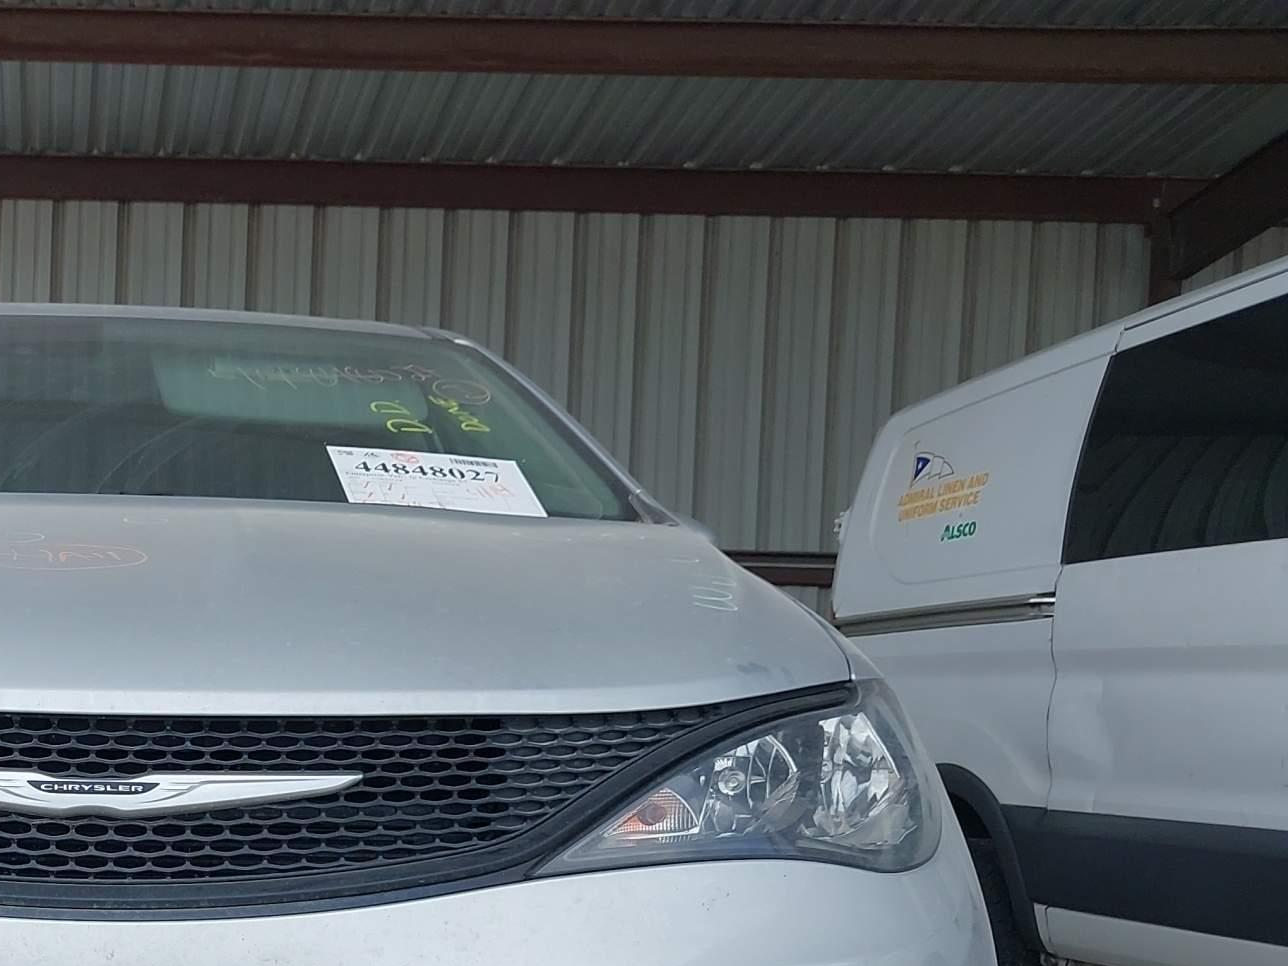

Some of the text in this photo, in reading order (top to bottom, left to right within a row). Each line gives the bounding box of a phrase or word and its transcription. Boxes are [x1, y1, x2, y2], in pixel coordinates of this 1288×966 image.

[355, 461, 499, 483] 44848027
[937, 479, 965, 497] LINEN
[967, 472, 990, 489] AND
[938, 490, 981, 513] SERVICE
[940, 520, 977, 542] ALSCO
[39, 783, 144, 793] CHRYSLER
